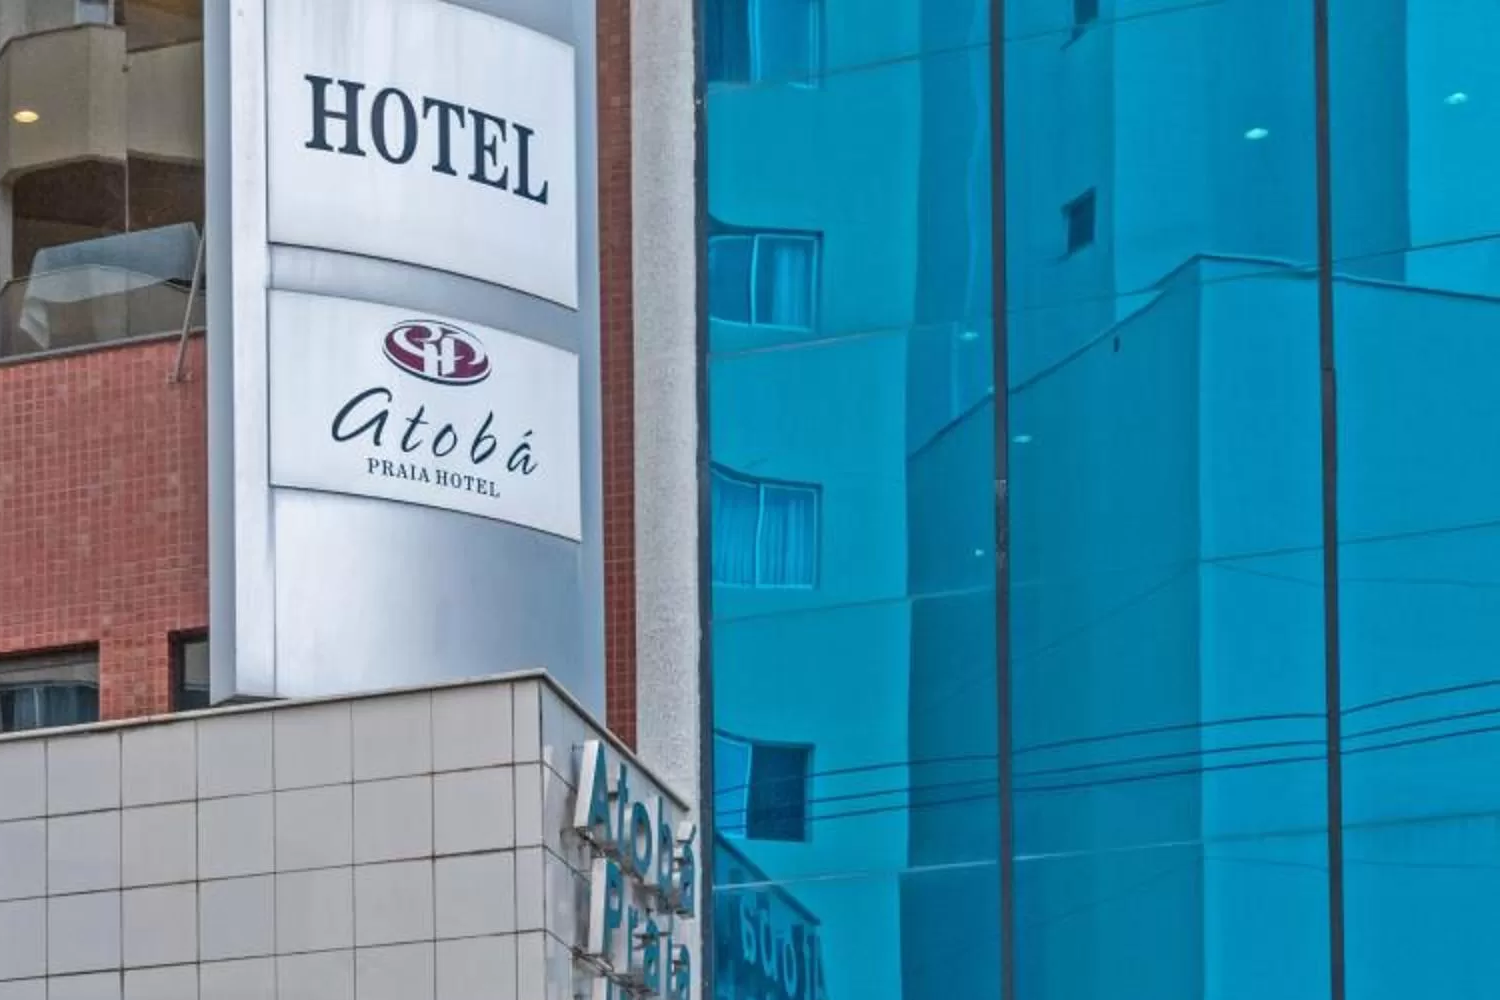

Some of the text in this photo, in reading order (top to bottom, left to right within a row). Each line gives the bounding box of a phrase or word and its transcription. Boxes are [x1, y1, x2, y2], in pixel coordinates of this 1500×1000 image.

[304, 73, 548, 205] HOTEL
[367, 457, 501, 498] PRAIA HOTEL
[574, 740, 697, 917] Atobá
